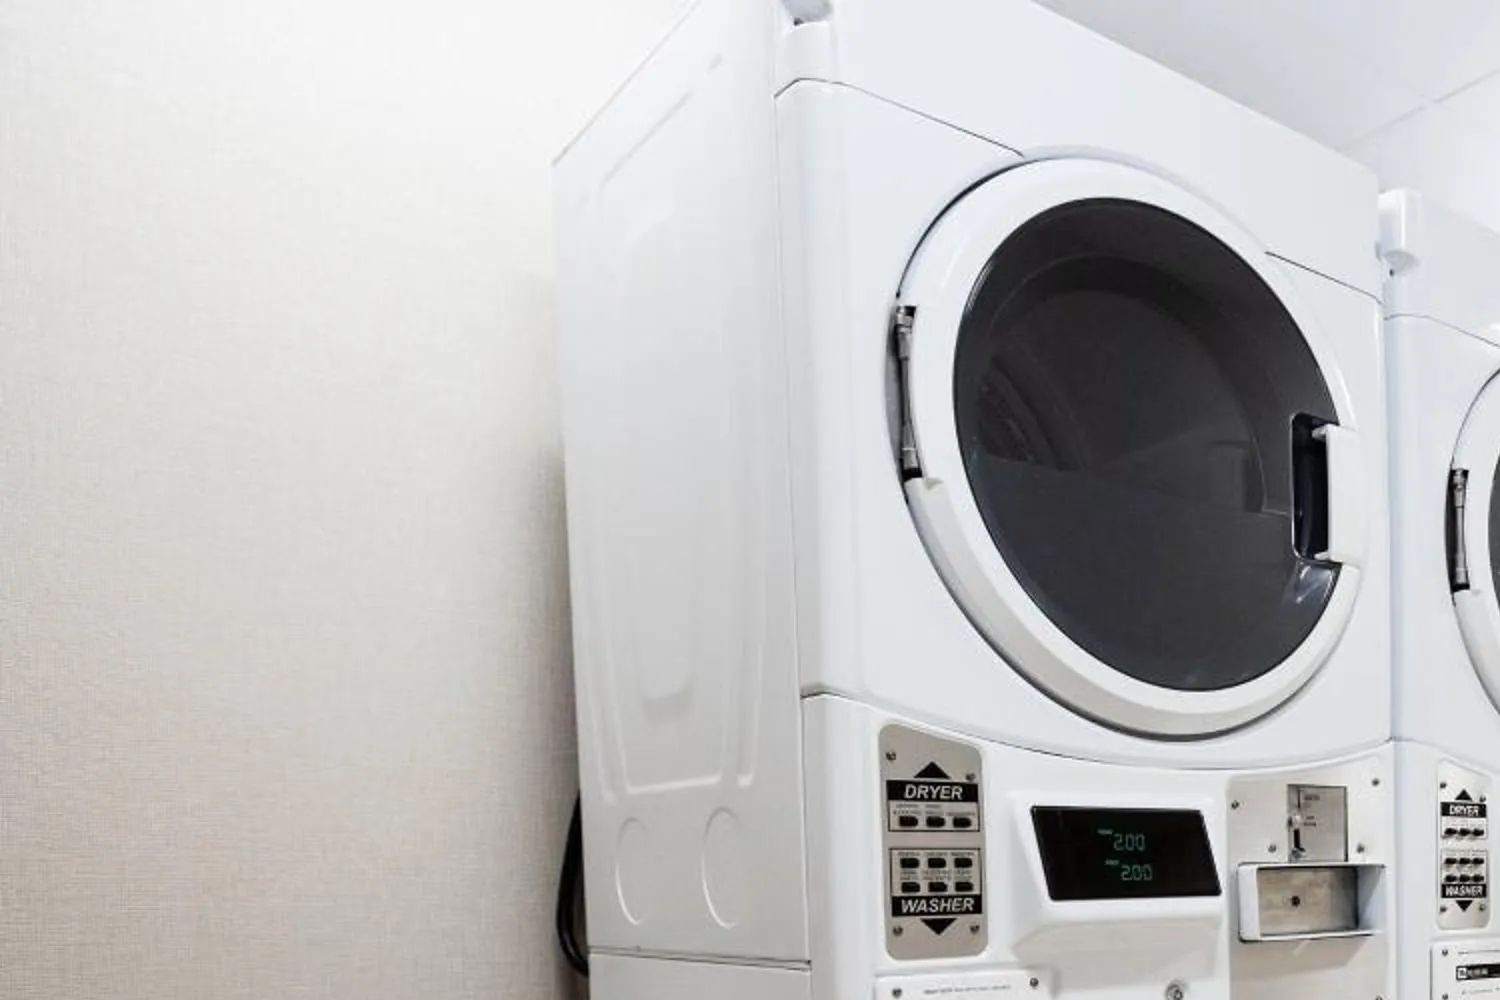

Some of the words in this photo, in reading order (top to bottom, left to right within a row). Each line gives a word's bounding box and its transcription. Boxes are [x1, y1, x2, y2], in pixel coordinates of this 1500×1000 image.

[904, 783, 963, 800] DRYER
[1449, 804, 1479, 817] DRYER
[901, 897, 975, 914] WASHER
